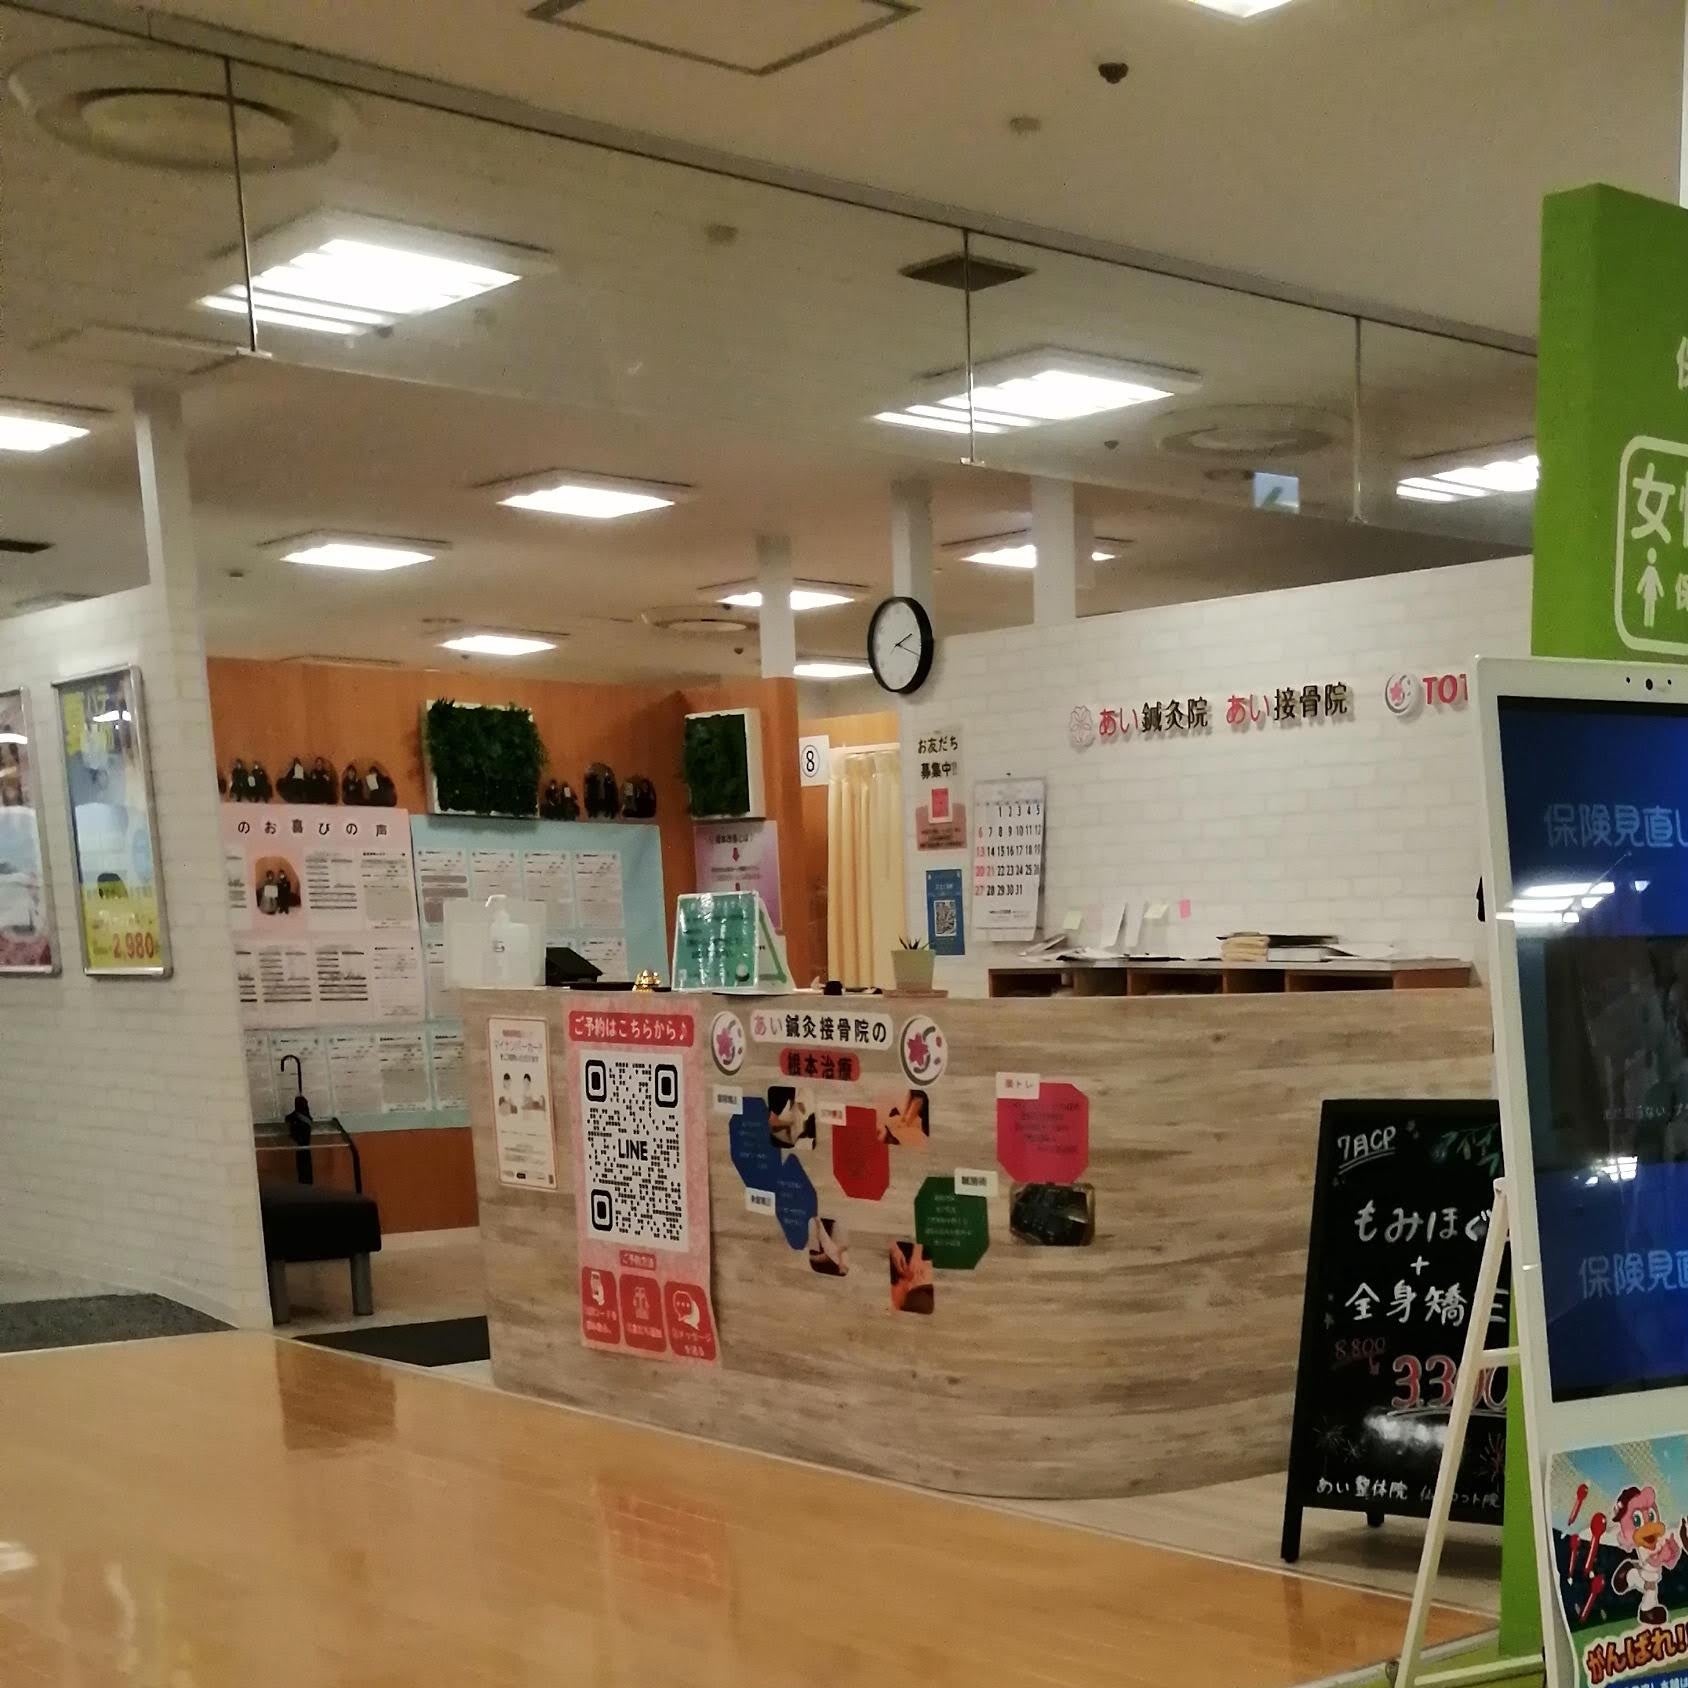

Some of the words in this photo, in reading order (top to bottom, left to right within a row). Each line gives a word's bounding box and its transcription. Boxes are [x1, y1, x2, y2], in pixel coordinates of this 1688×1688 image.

[1099, 696, 1208, 736] あい鍼灸院
[1226, 681, 1348, 725] あい接骨院
[917, 734, 958, 755] お友だち
[753, 1014, 887, 1043] あい鍼灸接骨院の
[787, 1051, 853, 1081] 根本治療
[618, 1138, 648, 1161] LINE
